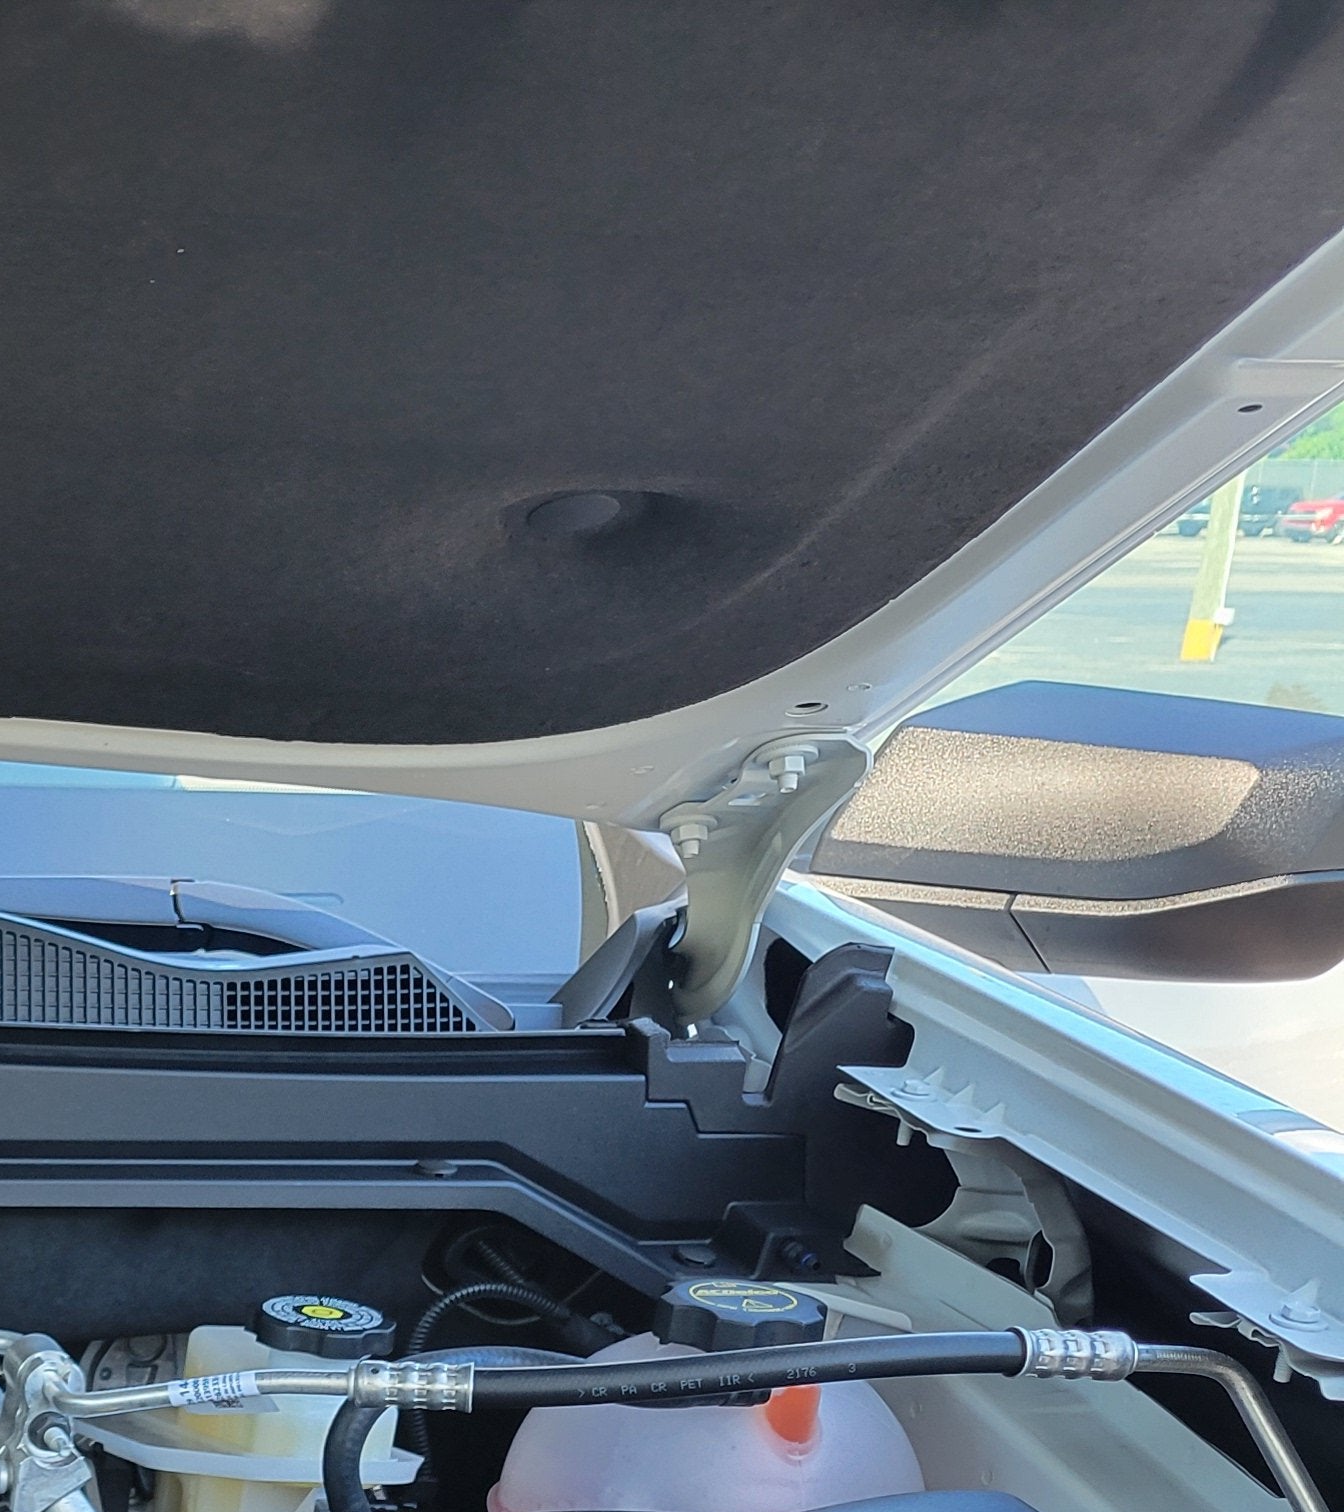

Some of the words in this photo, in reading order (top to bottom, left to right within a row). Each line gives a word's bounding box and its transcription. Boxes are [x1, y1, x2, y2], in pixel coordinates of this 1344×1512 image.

[786, 1367, 817, 1379] 2176
[591, 1386, 608, 1397] CR
[620, 1384, 637, 1395] PA
[650, 1382, 667, 1393] CR
[680, 1378, 704, 1390] PET
